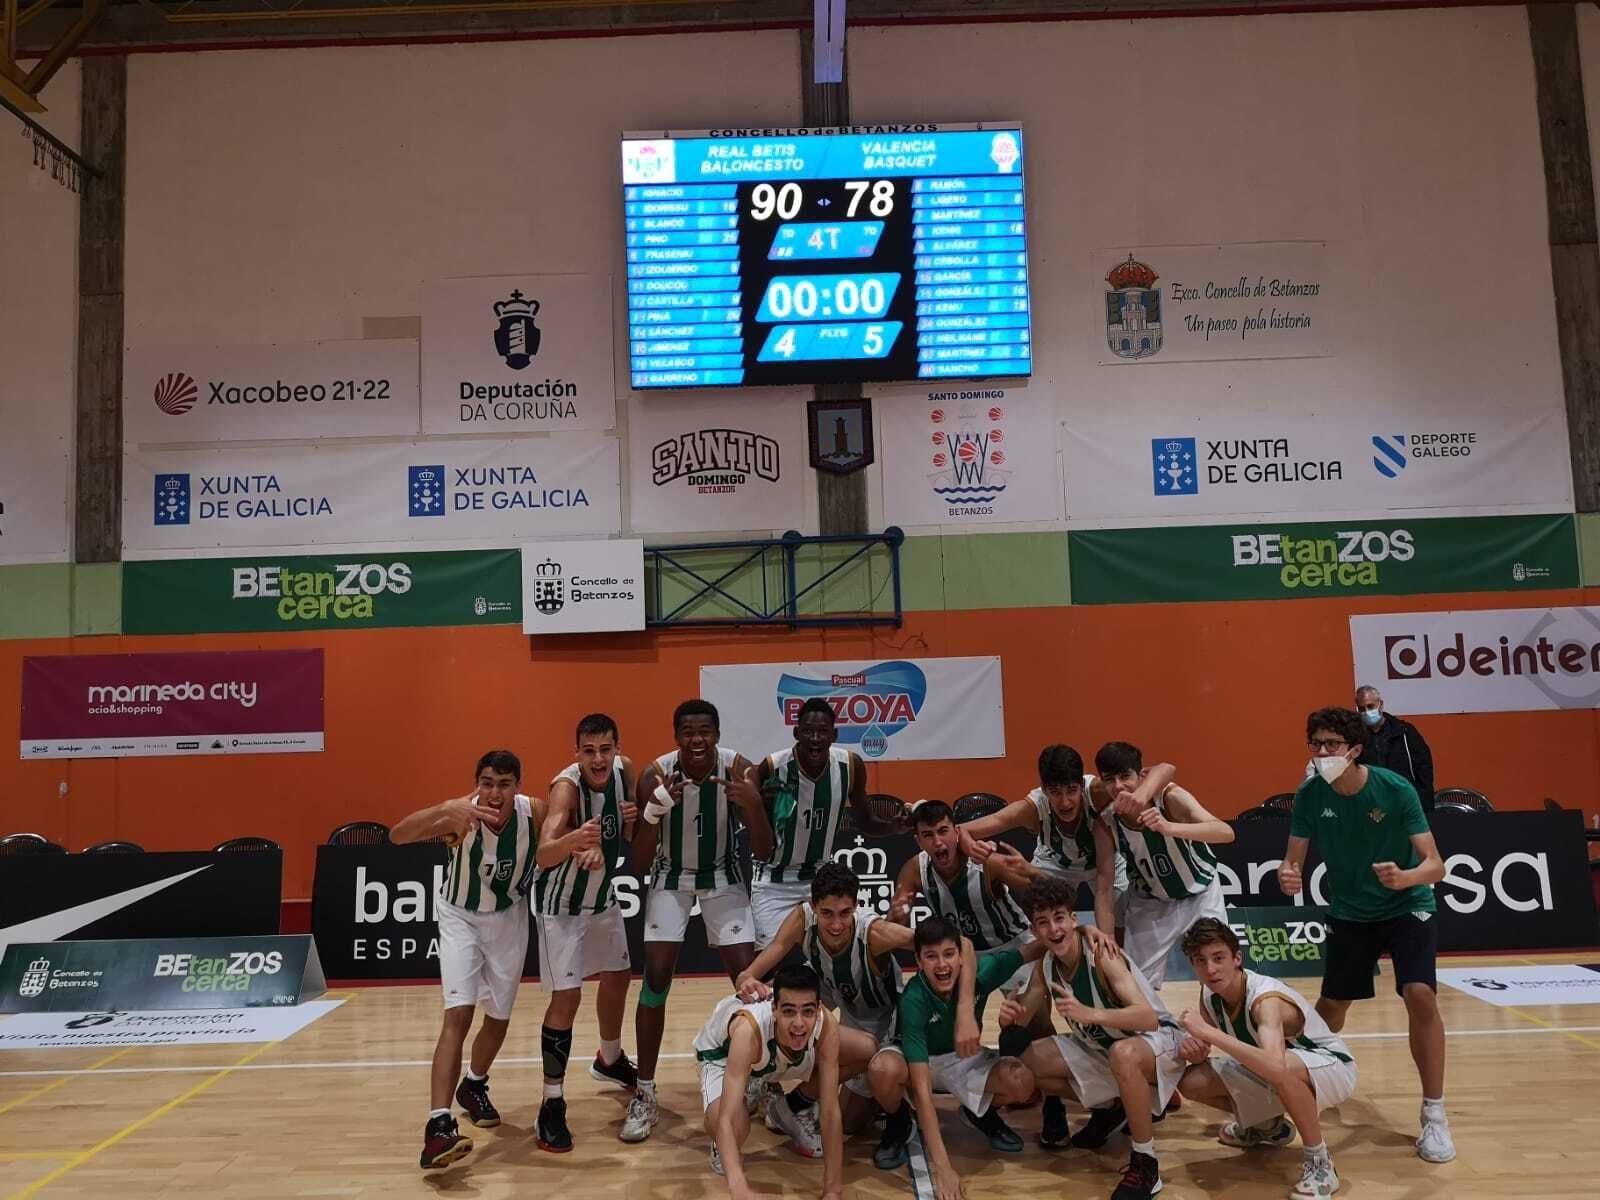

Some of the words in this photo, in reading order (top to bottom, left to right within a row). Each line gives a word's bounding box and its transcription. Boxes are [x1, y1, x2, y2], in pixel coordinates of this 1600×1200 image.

[709, 128, 808, 138] CONCELLO
[814, 127, 834, 136] de
[839, 124, 939, 135] BETANZOS
[708, 145, 747, 158] REAL
[752, 144, 796, 157] BETIS
[861, 141, 936, 155] VALENCIA
[701, 158, 804, 174] BALONCESTO
[864, 155, 937, 170] BASQUET
[750, 182, 803, 221] 90
[844, 180, 895, 218] 78
[807, 227, 841, 251] 4T
[767, 278, 885, 318] 00:00
[1205, 276, 1251, 300] Concello
[1253, 276, 1266, 297] de
[1269, 279, 1321, 297] Betanzos
[1184, 314, 1204, 332] Un
[1206, 317, 1238, 342] paseo
[1242, 308, 1267, 341] pola
[1270, 308, 1312, 330] historia
[773, 328, 797, 358] 4
[862, 325, 885, 356] 5
[207, 380, 327, 405] Xacobeo
[459, 379, 577, 403] Deputación
[927, 391, 958, 401] SANTO
[959, 390, 1005, 400] DOMINGO
[459, 403, 487, 422] DA
[493, 398, 578, 421] CORUÑA
[1207, 438, 1289, 460] XUNTA
[1410, 432, 1477, 446] DEPORTE
[652, 428, 780, 487] SANTO
[1411, 445, 1471, 458] GALEGO
[455, 466, 537, 487] XUNTA
[687, 474, 746, 486] DOMINGO
[1207, 464, 1238, 485] DE
[1243, 460, 1343, 483] GALICIA
[199, 475, 281, 496] XUNTA
[199, 500, 229, 519] DE
[235, 497, 333, 518] GALICIA
[454, 492, 485, 511] DE
[491, 489, 589, 510] GALICIA
[948, 506, 993, 517] BETANZOS
[1231, 529, 1415, 567] BEtanZOS
[232, 562, 412, 600] BEtanZOS
[1280, 560, 1378, 588] cerca
[276, 594, 374, 621] cerca
[833, 675, 864, 685] Pascual
[88, 681, 205, 704] marineda
[210, 680, 257, 708] city
[88, 703, 163, 716] ocio&shopping
[784, 694, 917, 727] BZOYA
[692, 812, 704, 838] 1
[802, 807, 824, 831] 11
[1248, 943, 1321, 962] cerca
[181, 973, 252, 993] cerca
